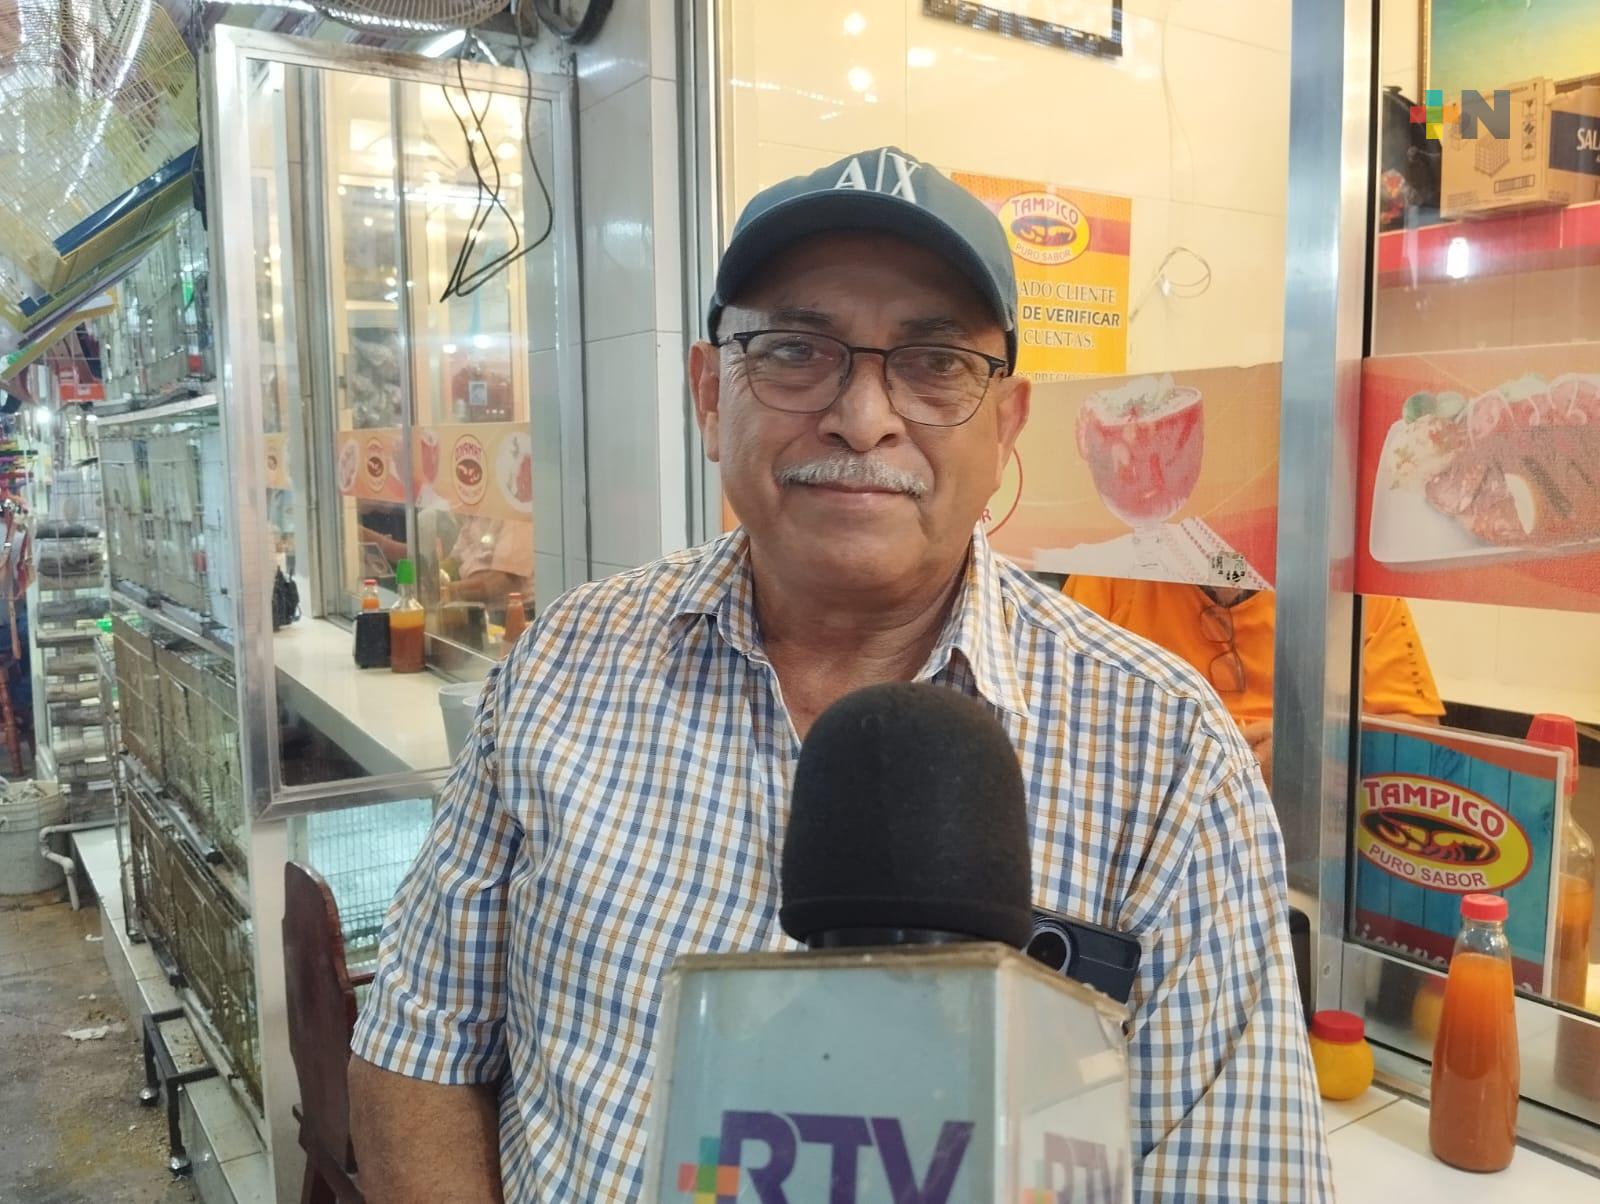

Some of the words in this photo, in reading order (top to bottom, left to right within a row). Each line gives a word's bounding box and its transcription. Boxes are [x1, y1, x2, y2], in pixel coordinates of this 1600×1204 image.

[1576, 128, 1600, 151] SAL
[1012, 197, 1079, 225] TAMPICO
[1016, 243, 1040, 259] PURO
[1042, 248, 1072, 261] SABOR
[1056, 283, 1115, 304] CLIENTE
[1023, 305, 1042, 320] DE
[1046, 307, 1120, 326] VERIFICAR
[1023, 329, 1095, 348] CUENTAS.
[1363, 780, 1505, 838] TAMPICO
[1369, 844, 1416, 876] PURO
[1420, 867, 1487, 887] SABOR
[718, 1110, 976, 1204] RTV
